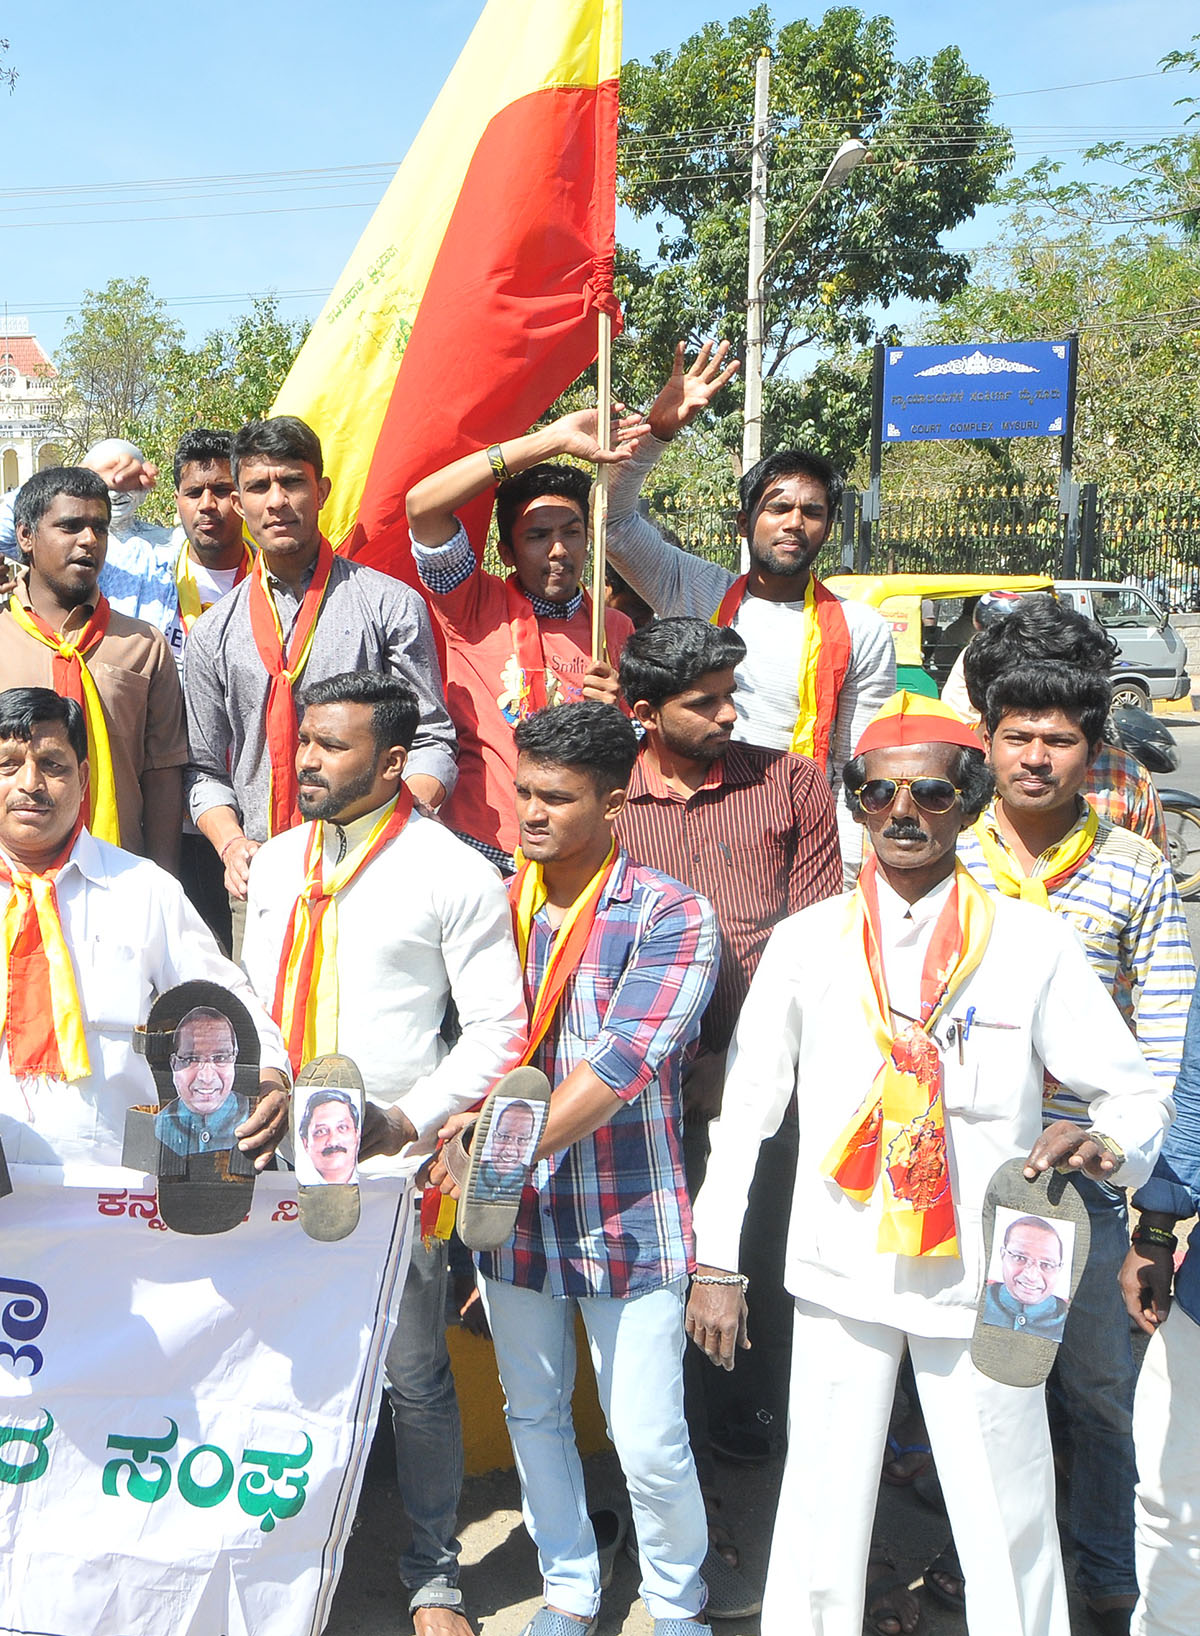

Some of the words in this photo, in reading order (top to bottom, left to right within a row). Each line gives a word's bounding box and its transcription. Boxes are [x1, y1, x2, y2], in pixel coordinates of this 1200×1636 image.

[911, 424, 941, 434] COURT
[949, 422, 994, 433] COMPLEX
[1001, 420, 1040, 431] MYSURU
[552, 655, 587, 674] Smili
[102, 1416, 314, 1532] ಸಂಘ
